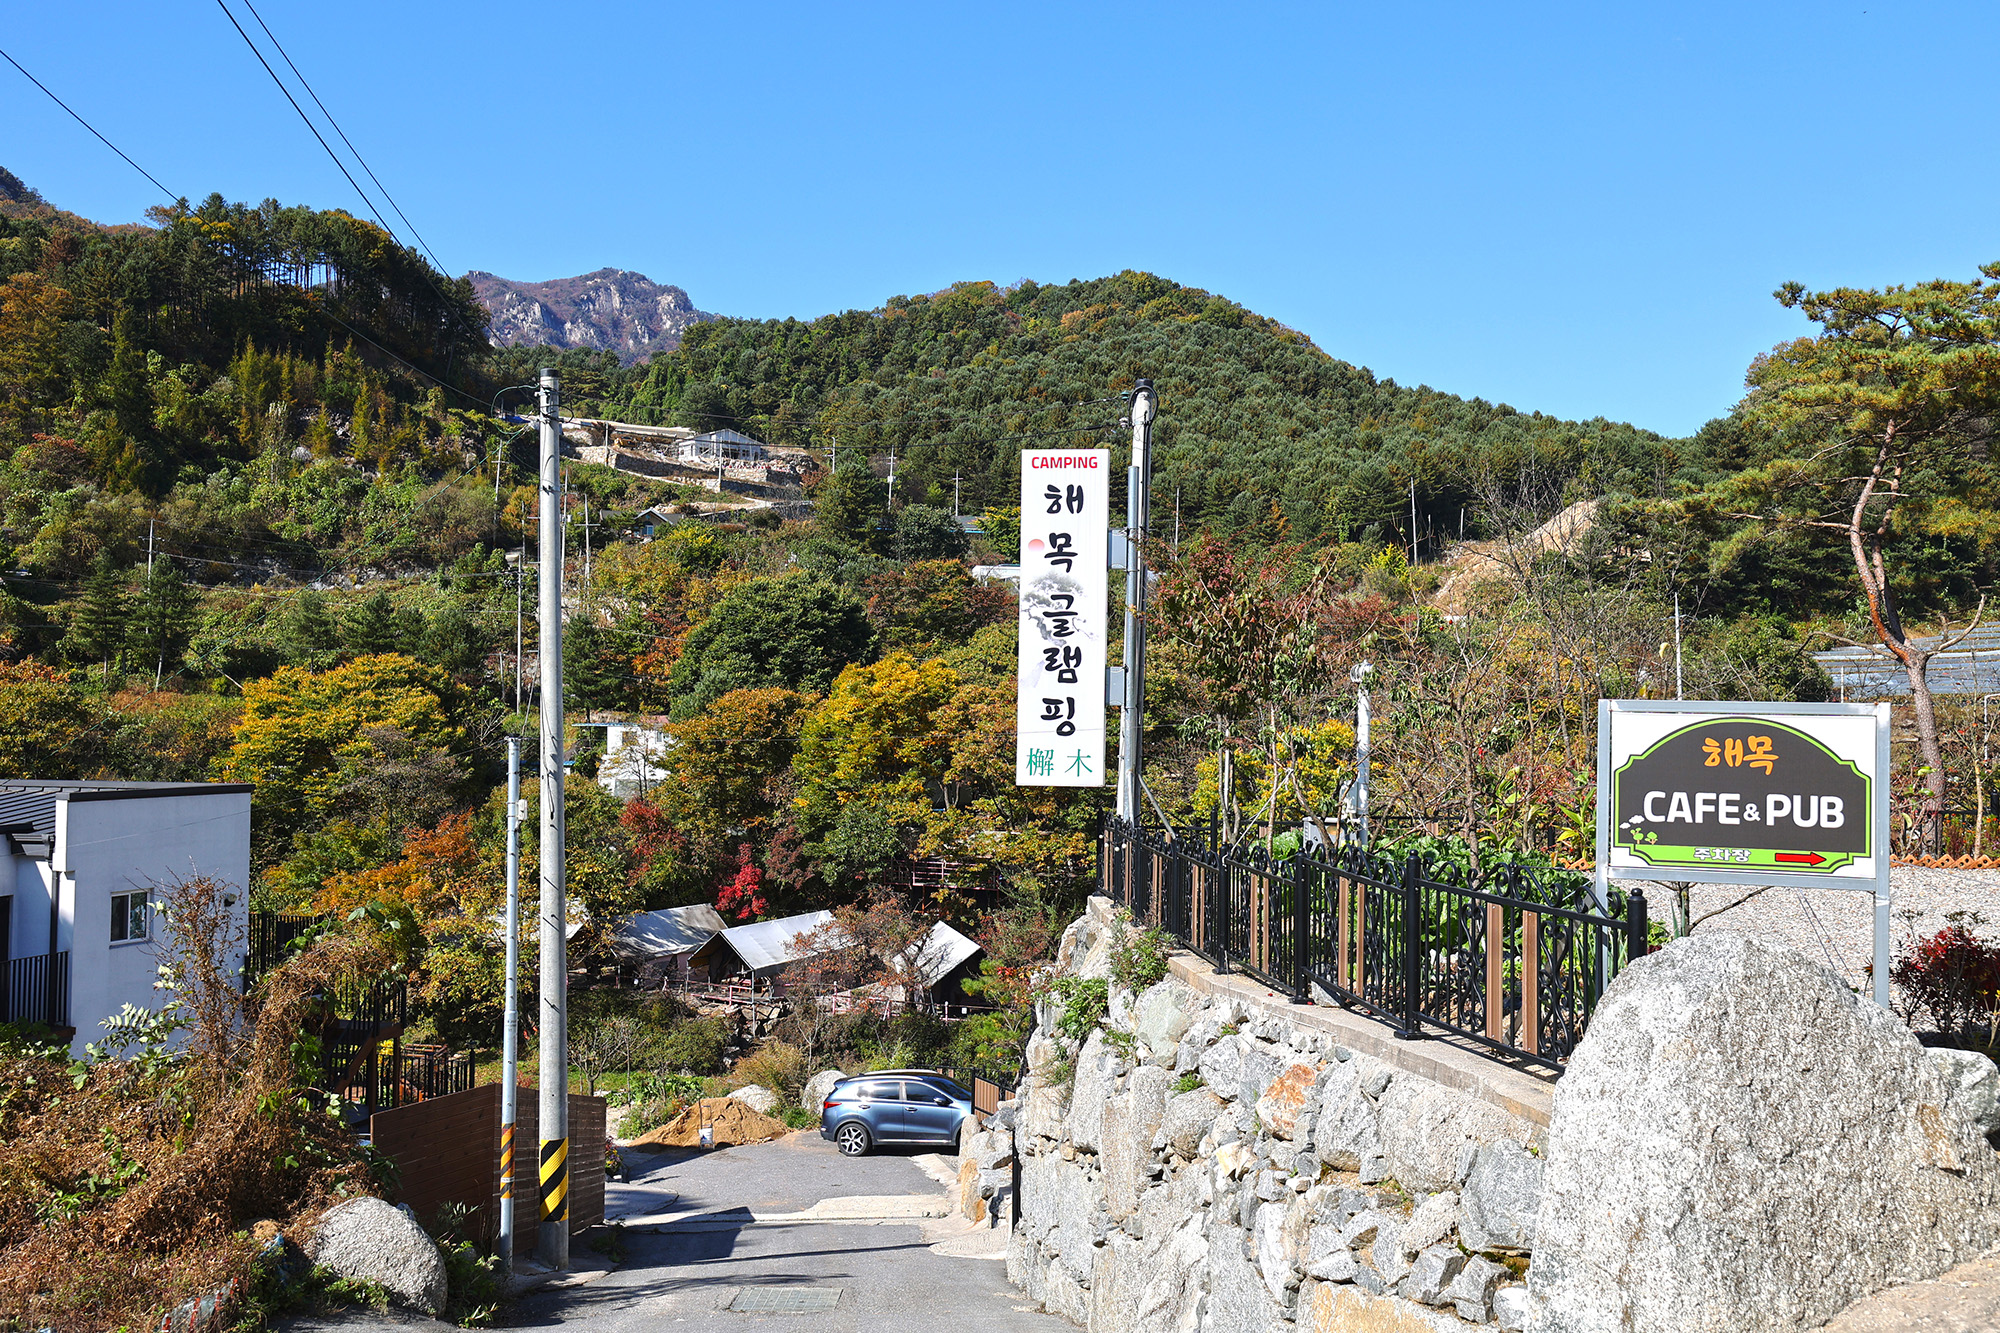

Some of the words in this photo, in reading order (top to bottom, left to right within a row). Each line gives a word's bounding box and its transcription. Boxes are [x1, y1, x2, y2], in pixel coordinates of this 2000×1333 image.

[1031, 456, 1098, 469] CAMPING
[1702, 735, 1779, 775] 해목
[1693, 848, 1751, 863] 주차장
